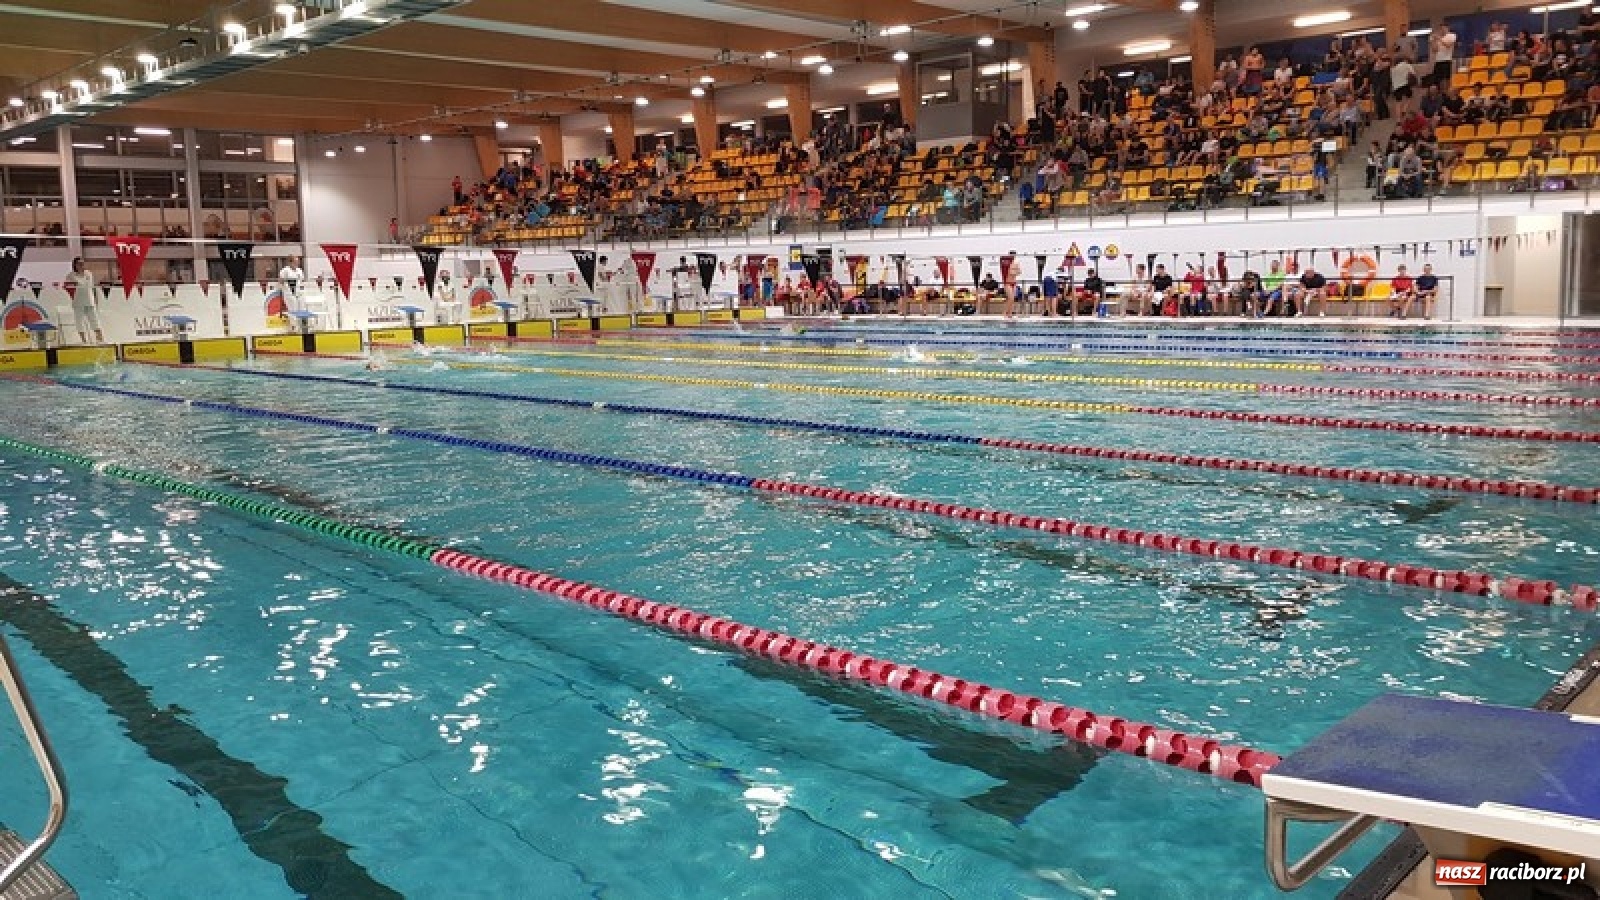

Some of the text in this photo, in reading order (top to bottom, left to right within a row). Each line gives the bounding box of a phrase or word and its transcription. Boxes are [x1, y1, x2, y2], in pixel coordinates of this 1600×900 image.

[0, 246, 17, 258] YR
[116, 241, 141, 256] TYR
[223, 248, 247, 259] TYR
[329, 251, 351, 262] TYR
